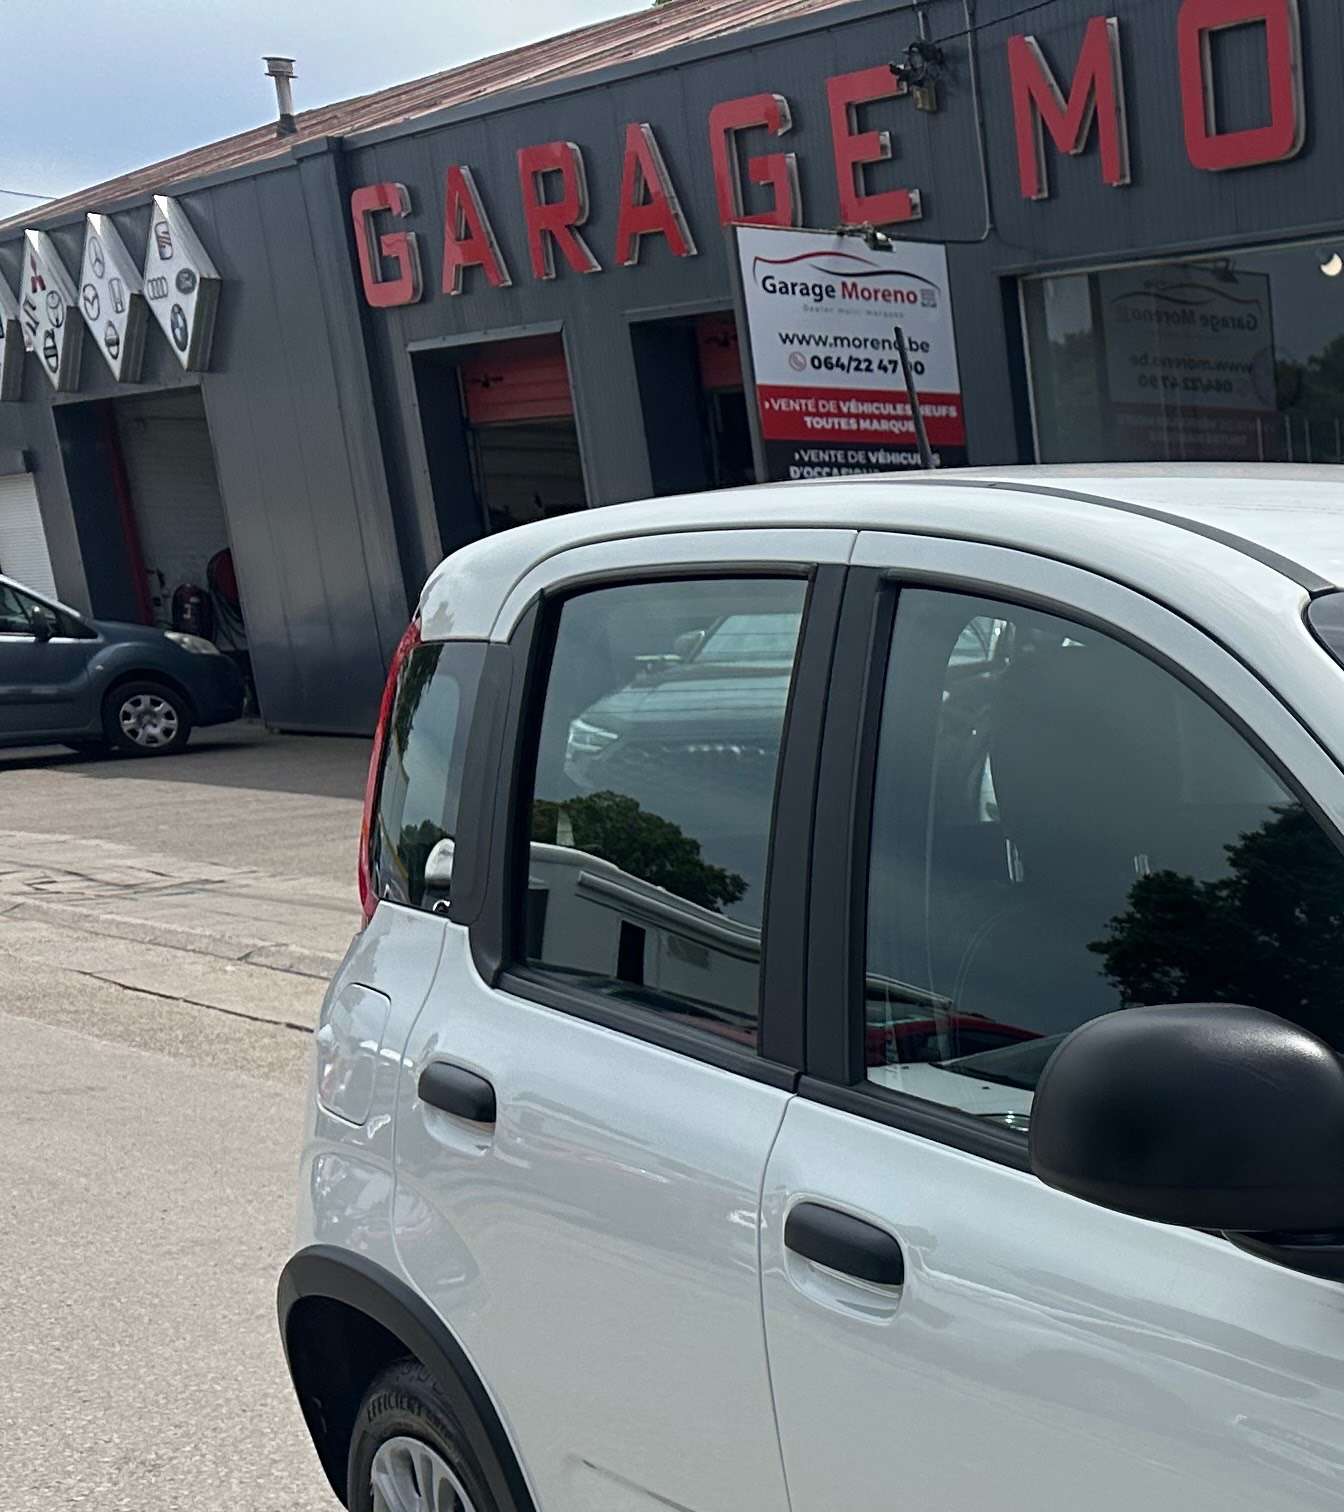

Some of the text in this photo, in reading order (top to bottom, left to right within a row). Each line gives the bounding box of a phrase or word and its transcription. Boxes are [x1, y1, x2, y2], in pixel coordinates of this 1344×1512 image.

[352, 66, 920, 308] GARAGE
[762, 275, 836, 302] Garage
[841, 281, 918, 305] Moreno
[811, 355, 874, 373] 064/22
[877, 358, 898, 373] 47
[818, 399, 838, 413] DE
[804, 416, 916, 434] TOUTES MARQUE
[800, 448, 847, 463] VENTE
[848, 451, 866, 463] DE
